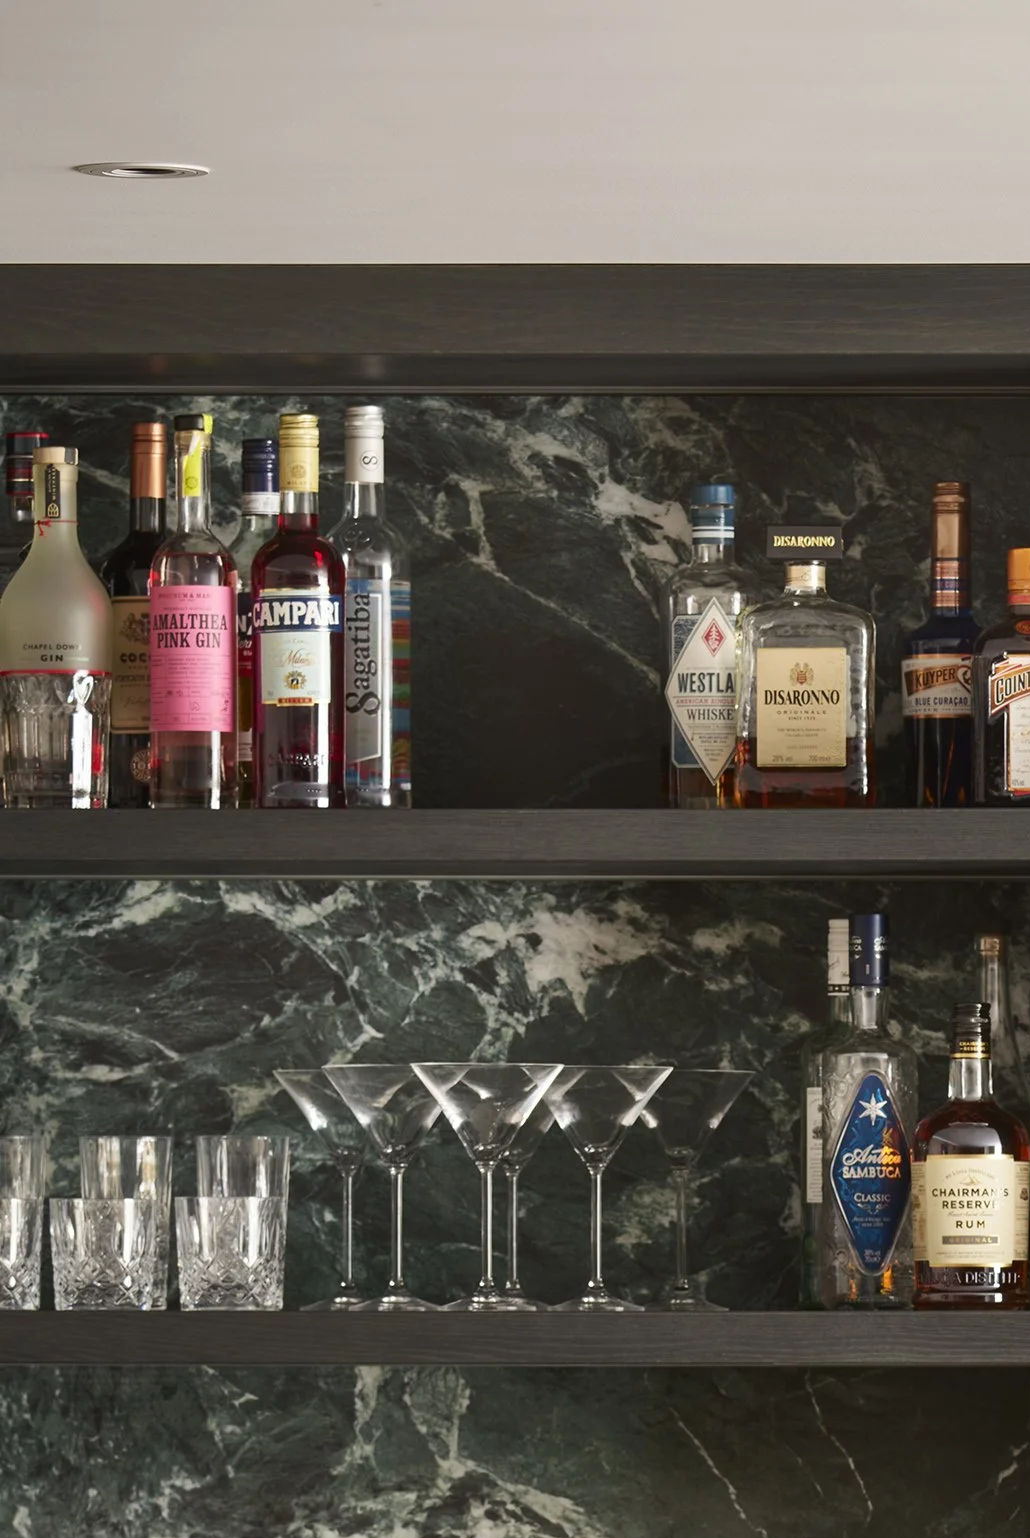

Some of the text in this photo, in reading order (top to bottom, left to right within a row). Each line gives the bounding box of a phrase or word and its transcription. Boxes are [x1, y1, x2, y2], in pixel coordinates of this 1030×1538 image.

[773, 535, 836, 548] DISARONNO
[253, 600, 340, 627] CAMPARI
[153, 613, 228, 631] AMALTHEA
[22, 643, 53, 651] CHAPEL
[157, 632, 191, 649] PINK
[195, 631, 221, 649] GIN
[40, 654, 64, 662] GIN
[346, 593, 380, 716] Sagatiba
[678, 672, 736, 694] WESTLA
[915, 667, 956, 689] KUYPER
[764, 689, 841, 707] DISARONNO
[914, 696, 931, 706] BLUE
[686, 708, 736, 721] WHISKE
[842, 1166, 902, 1179] SAMBUCA
[955, 1220, 986, 1229] RUM
